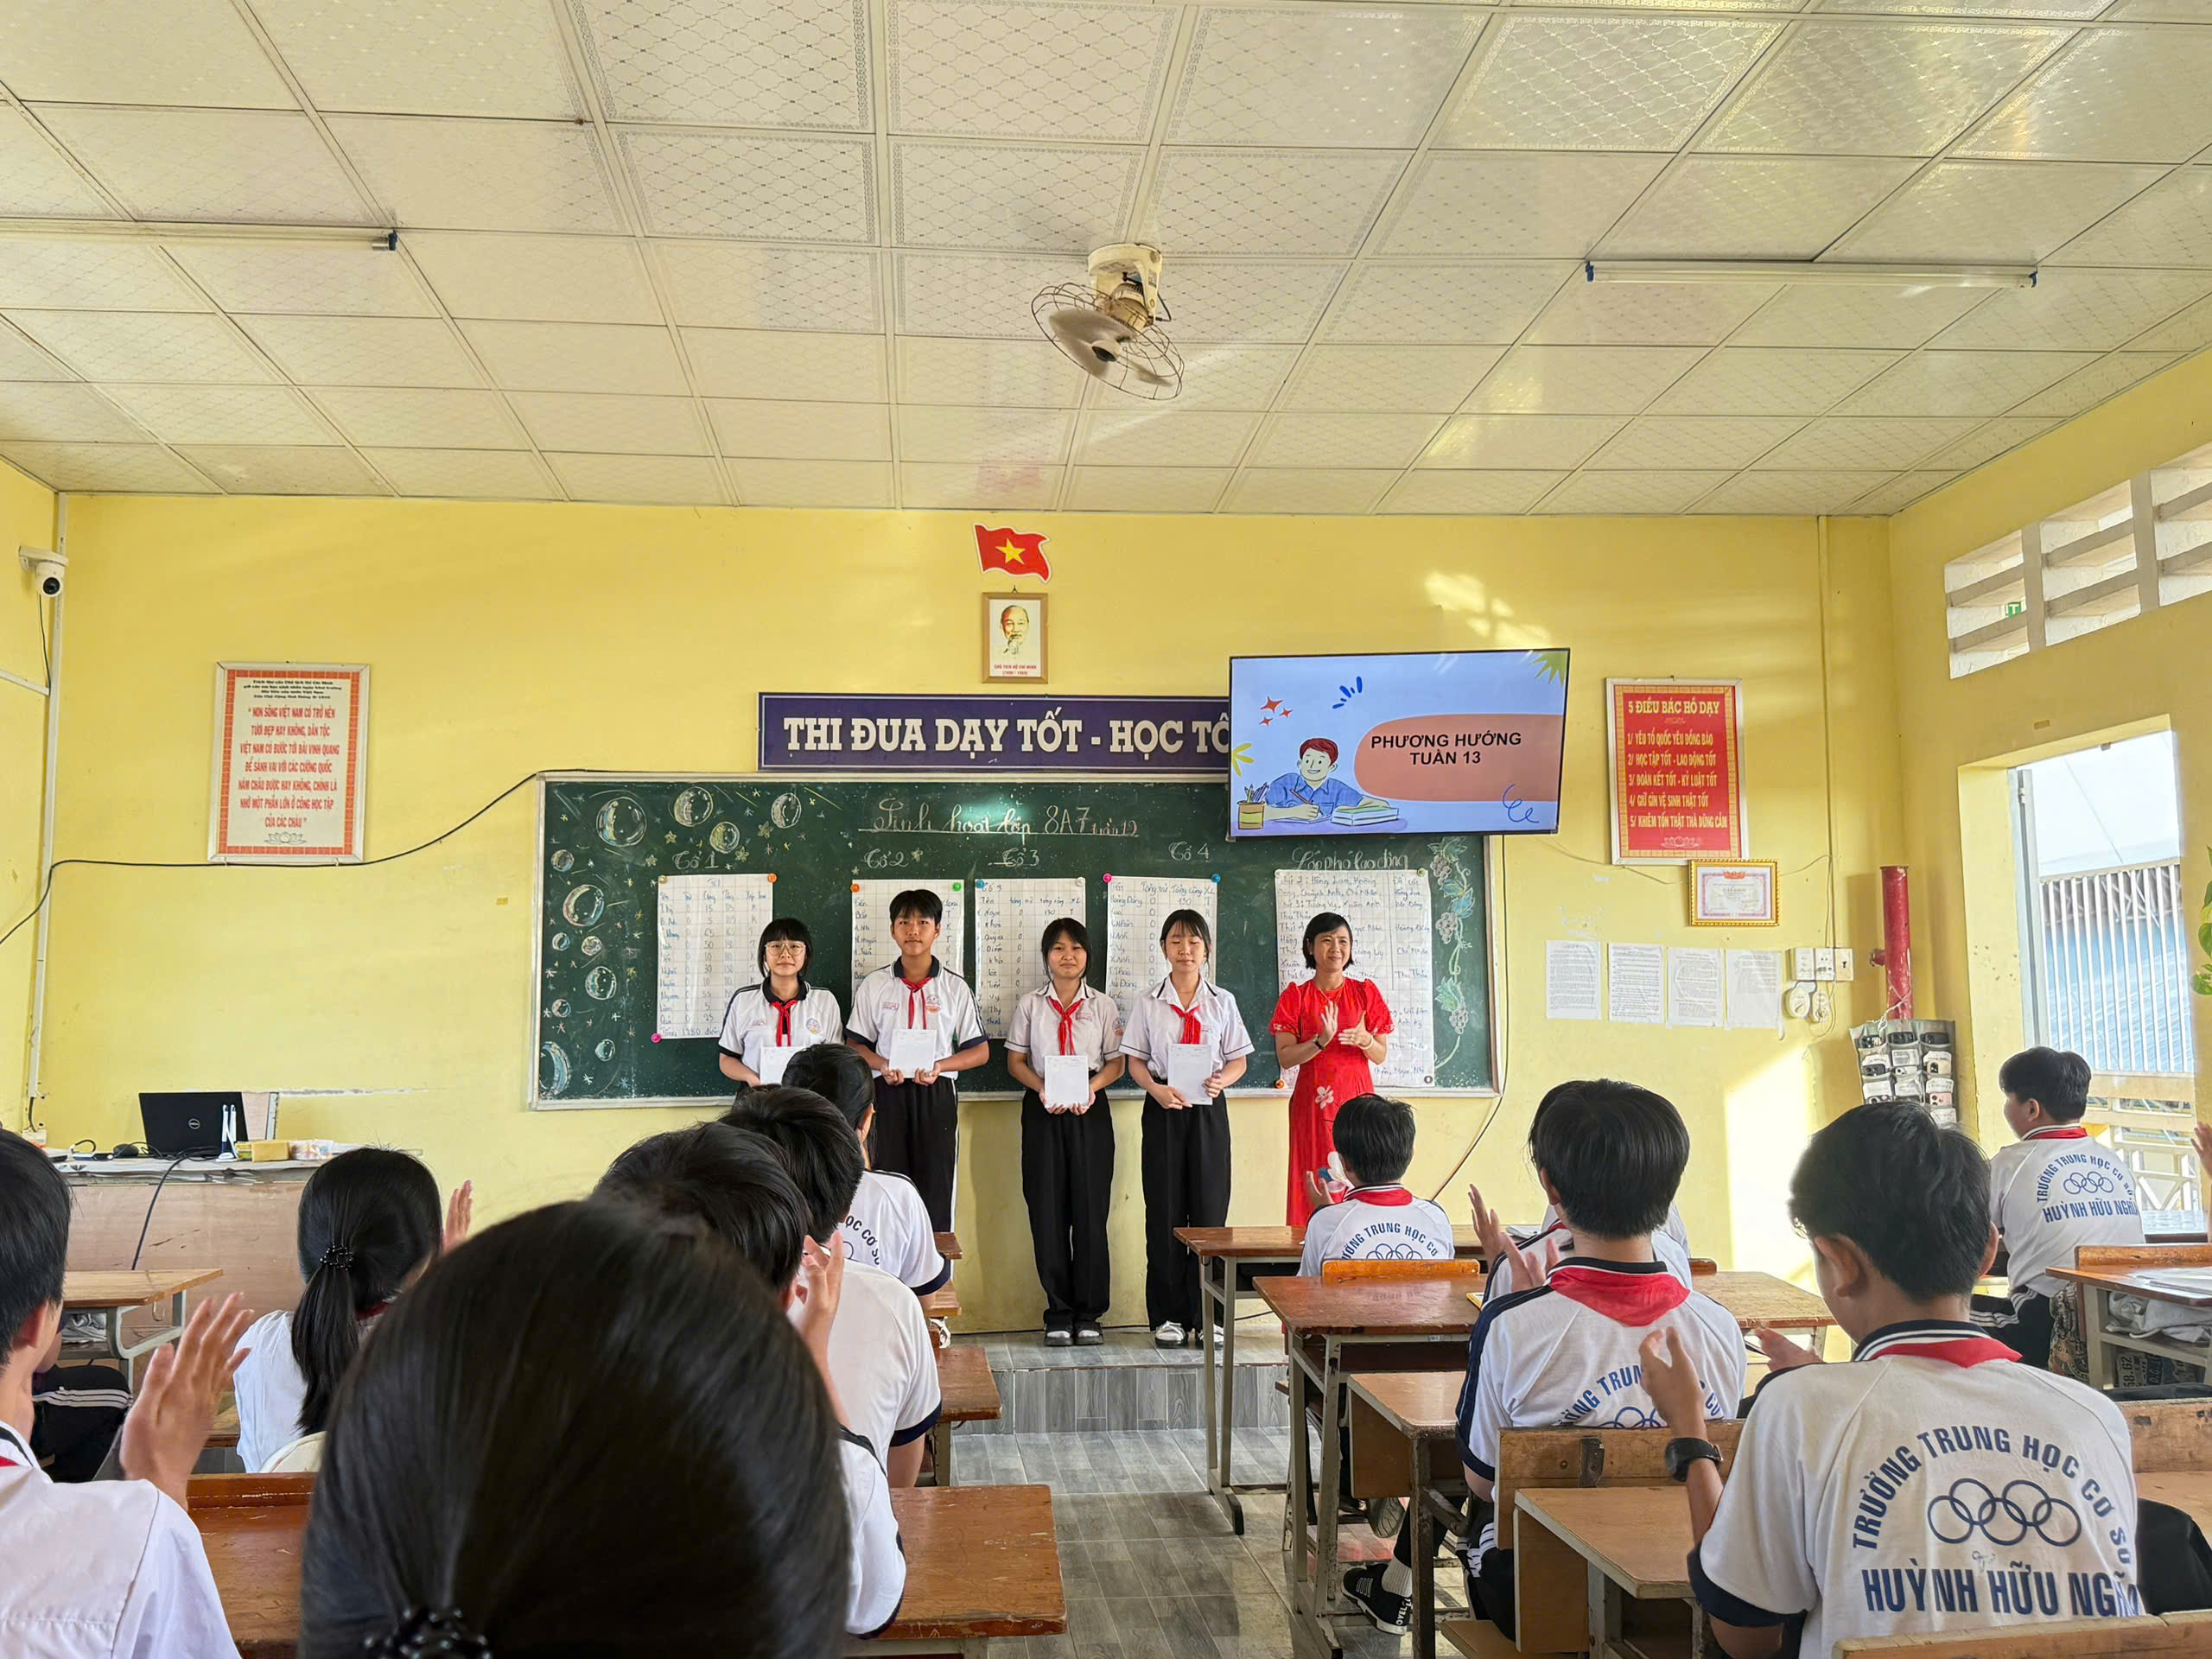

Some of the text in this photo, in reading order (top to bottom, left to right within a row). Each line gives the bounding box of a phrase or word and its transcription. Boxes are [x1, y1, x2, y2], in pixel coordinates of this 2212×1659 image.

[1628, 696, 1720, 718] 5 ĐIỀU BÁC HỒ DẠY
[784, 717, 843, 752] THI
[850, 717, 926, 752] ĐUA
[935, 718, 1009, 760] DẠY
[1017, 707, 1082, 753] TỐT
[1109, 719, 1184, 760] HỌC
[1371, 730, 1522, 748] PHƯƠNG HƯỚNG
[1635, 729, 1647, 745] YÊU
[1656, 729, 1672, 747] QUỐC
[1673, 729, 1685, 745] YÊU
[1464, 751, 1481, 764] 13
[1636, 753, 1648, 767] HỌC
[1649, 750, 1660, 767] TẬP
[1661, 750, 1671, 766] TỐT
[1676, 753, 1688, 766] LAO
[1706, 750, 1716, 766] TỐT
[1653, 771, 1664, 786] KẾT
[1666, 771, 1676, 786] TỐT
[1707, 771, 1718, 787] TỐT
[1659, 791, 1667, 809] VỆ
[1668, 795, 1681, 807] SINH
[1682, 791, 1697, 809] THẬT
[1698, 791, 1709, 807] TỐT
[1045, 805, 1090, 835] 8A7
[1670, 812, 1685, 830] THẬT
[672, 850, 719, 870] Tổ 1
[864, 849, 909, 868] Tổ 2
[1030, 849, 1040, 866] 3
[1169, 842, 1210, 861] Tổ 4
[2037, 1164, 2059, 1203] TRƯỜNG
[2055, 1154, 2088, 1167] TRUNG
[2090, 1155, 2110, 1168] HỌC
[2043, 1201, 2088, 1224] HUỲNH
[2088, 1198, 2113, 1217] HỮU
[845, 1215, 862, 1232] ỌC
[1363, 1223, 1401, 1237] TRUNG
[1405, 1225, 1426, 1241] HỌC
[1853, 1446, 1922, 1550] TRƯỜNG
[1916, 1426, 2012, 1459] TRUNG
[2022, 1434, 2080, 1479] HỌC
[2082, 1479, 2115, 1517] CƠ
[1861, 1558, 1979, 1613] HUỲNH
[1986, 1560, 2060, 1617] HỮU
